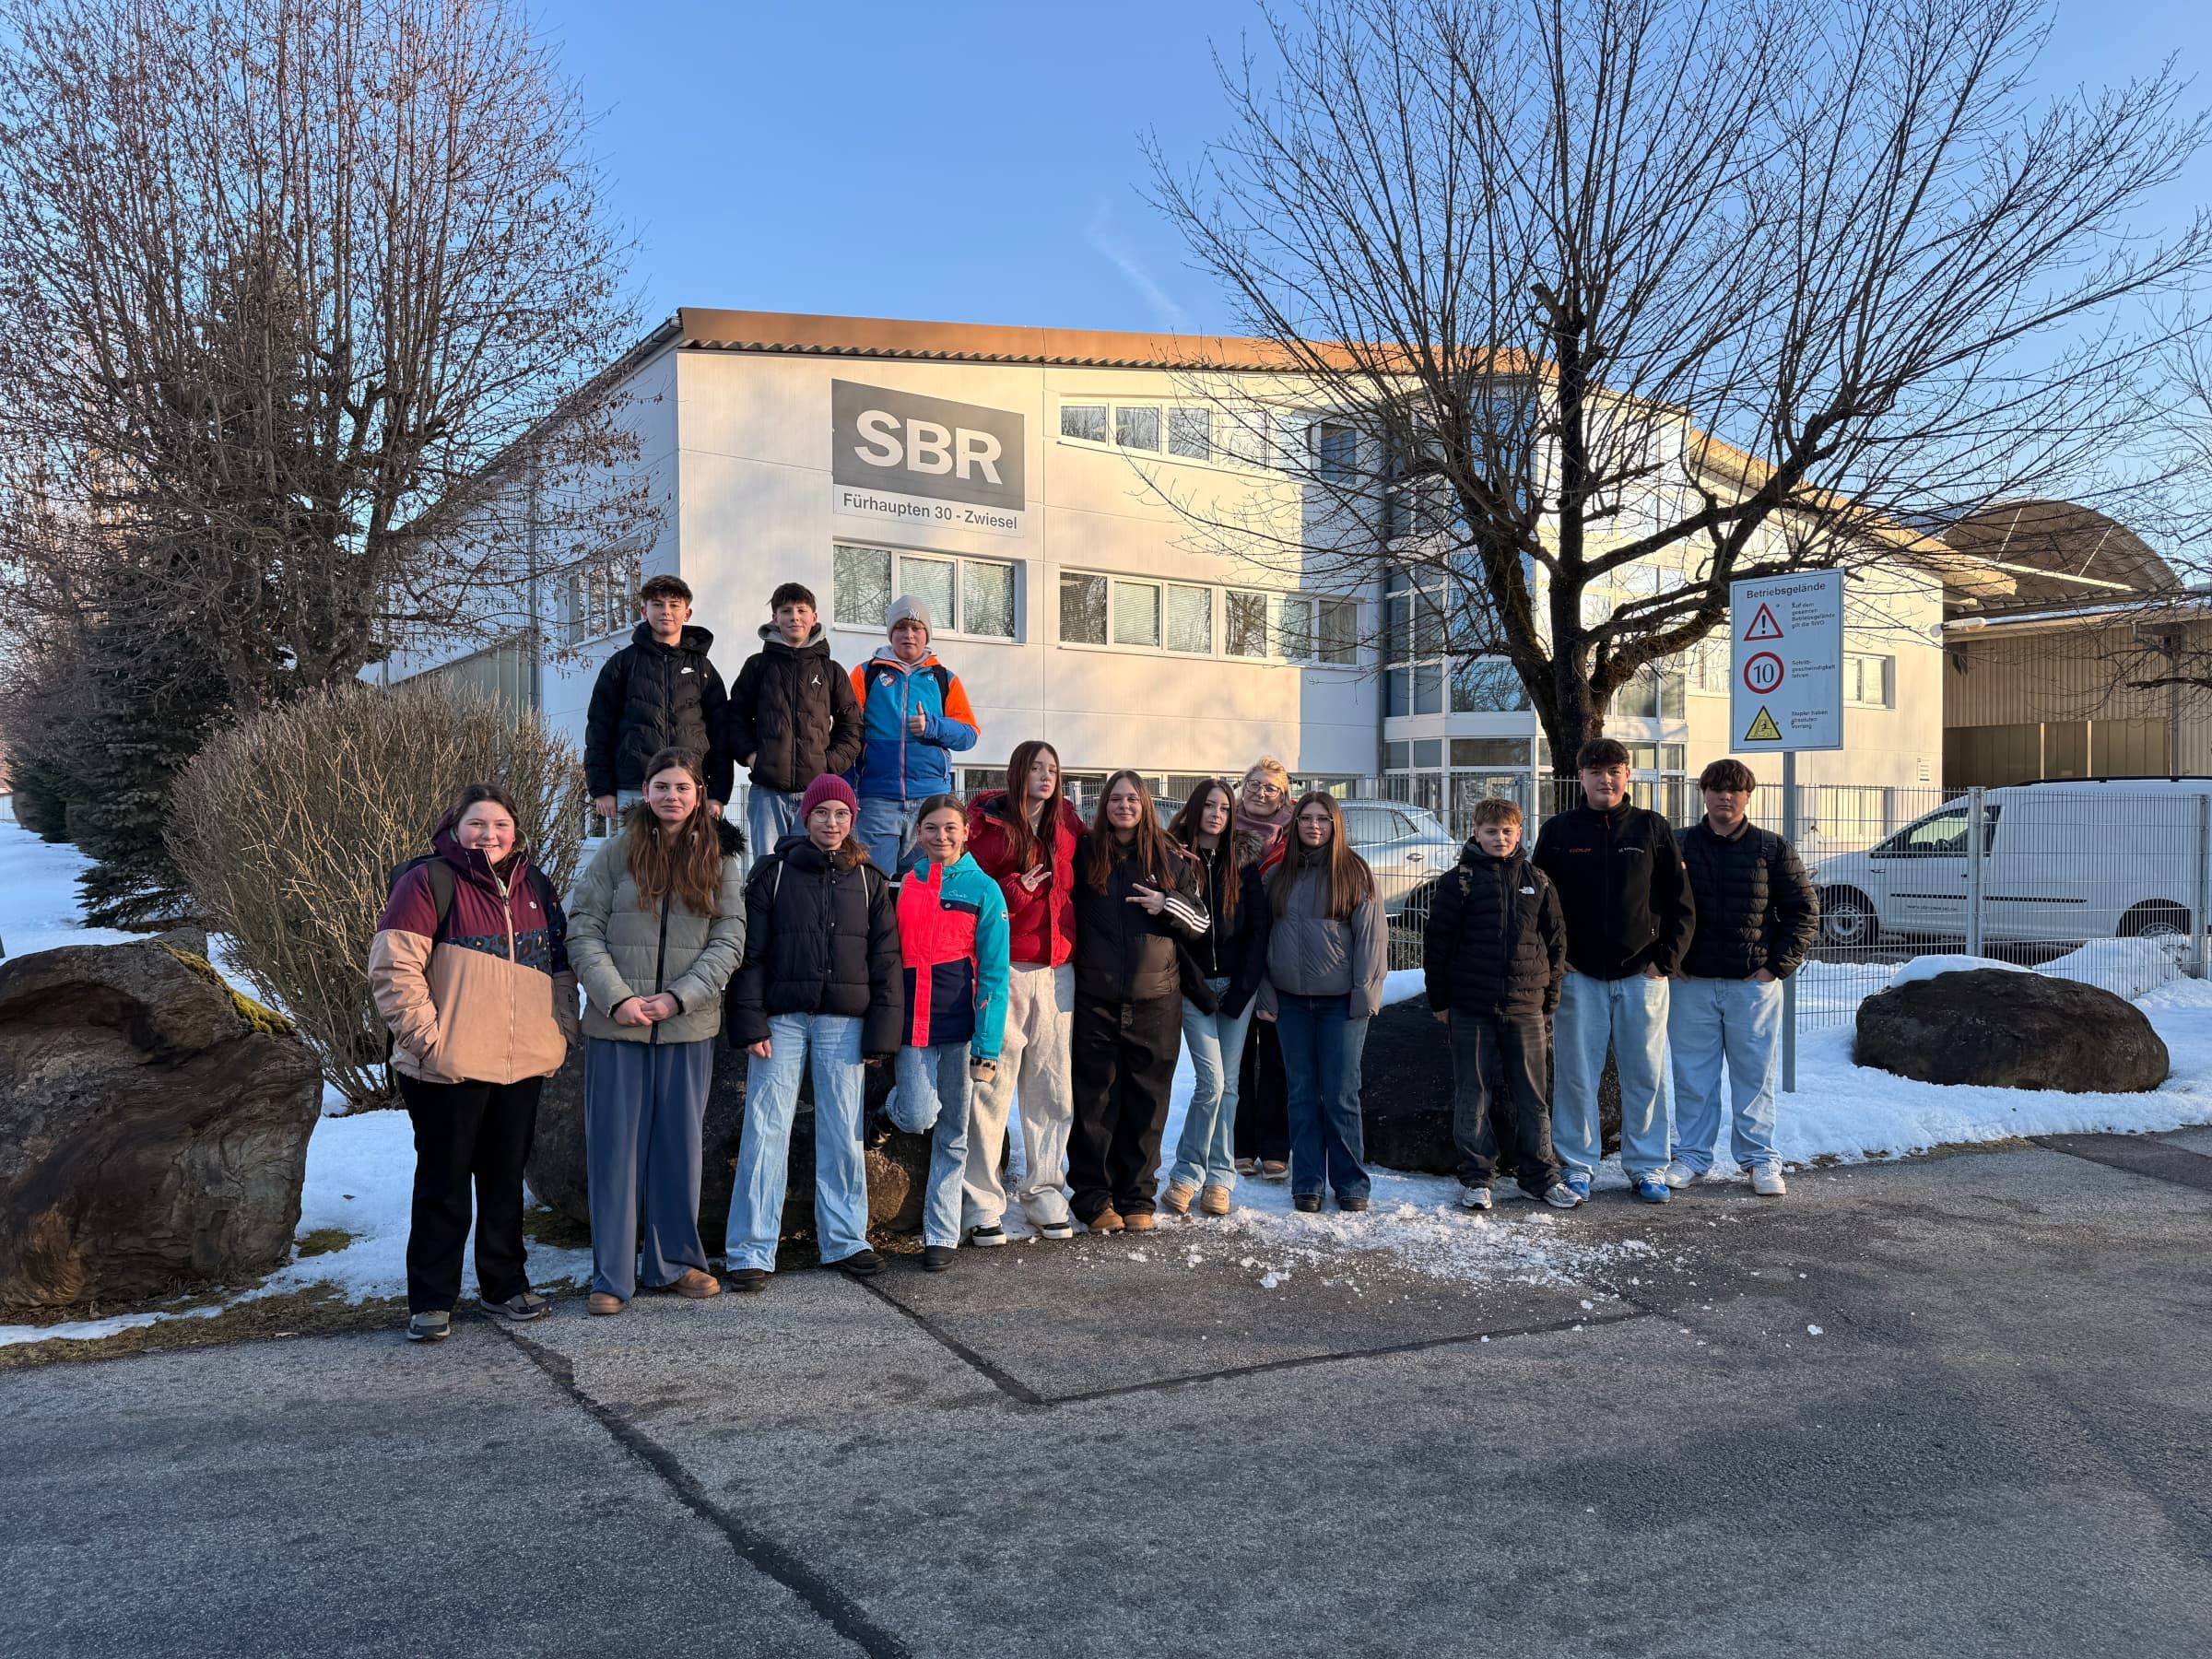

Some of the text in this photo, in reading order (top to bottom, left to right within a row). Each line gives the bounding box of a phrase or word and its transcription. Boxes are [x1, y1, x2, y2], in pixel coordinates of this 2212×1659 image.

[853, 409, 1004, 485] SBR
[842, 492, 931, 518] Fürhaupten
[935, 507, 953, 521] 30
[964, 510, 1018, 530] Zwiesel
[1747, 582, 1827, 599] Betriebsgelände
[1792, 612, 1836, 622] Betriebsgelände
[1753, 664, 1774, 684] 10
